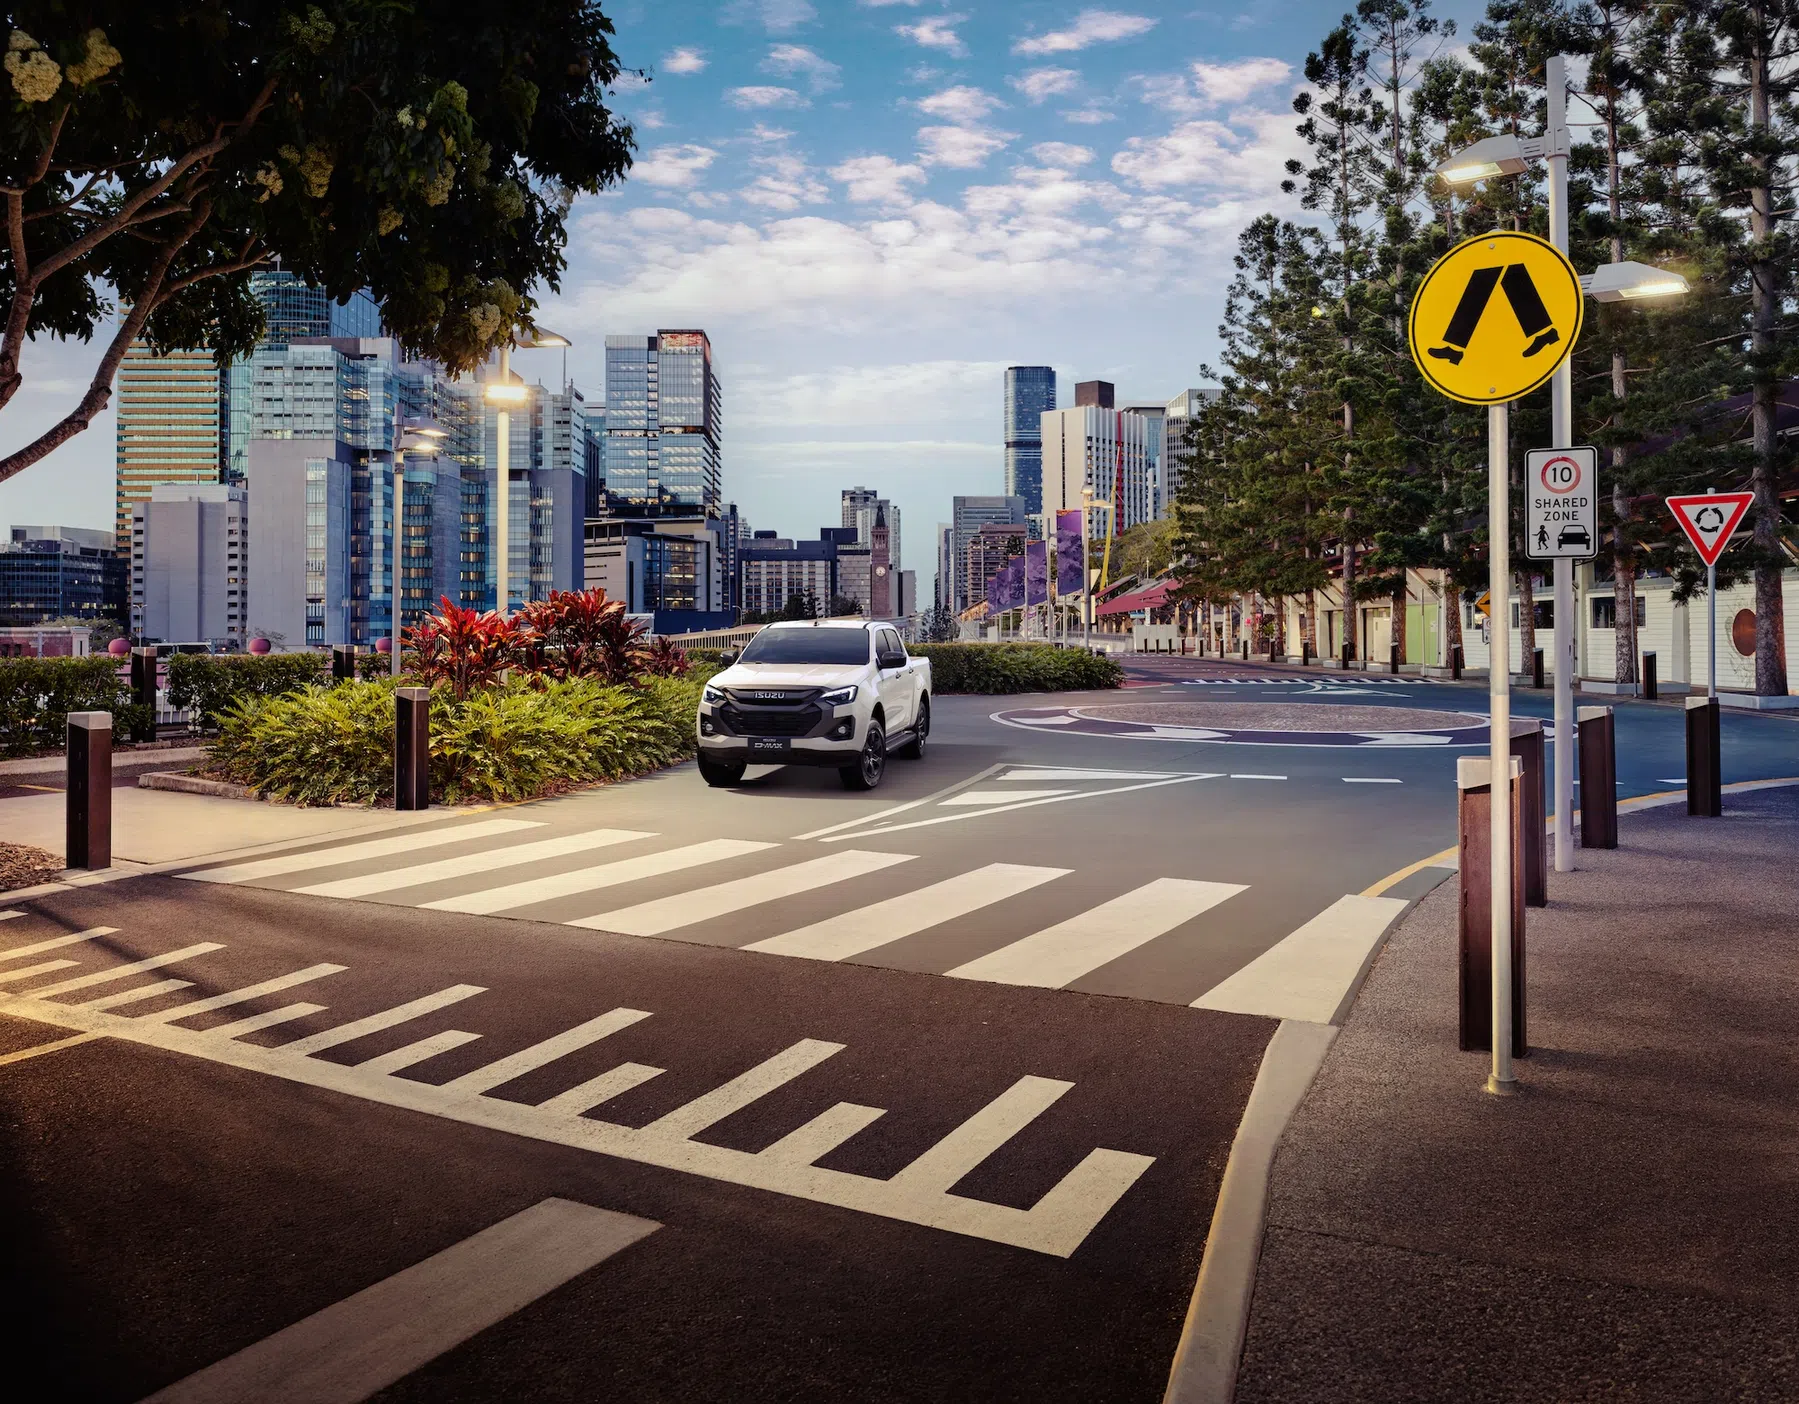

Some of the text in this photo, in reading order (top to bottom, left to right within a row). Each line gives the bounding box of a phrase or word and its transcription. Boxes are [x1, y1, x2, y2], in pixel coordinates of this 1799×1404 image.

[1552, 467, 1572, 483] 10
[1535, 498, 1588, 509] SHARED
[1544, 511, 1579, 521] ZONE
